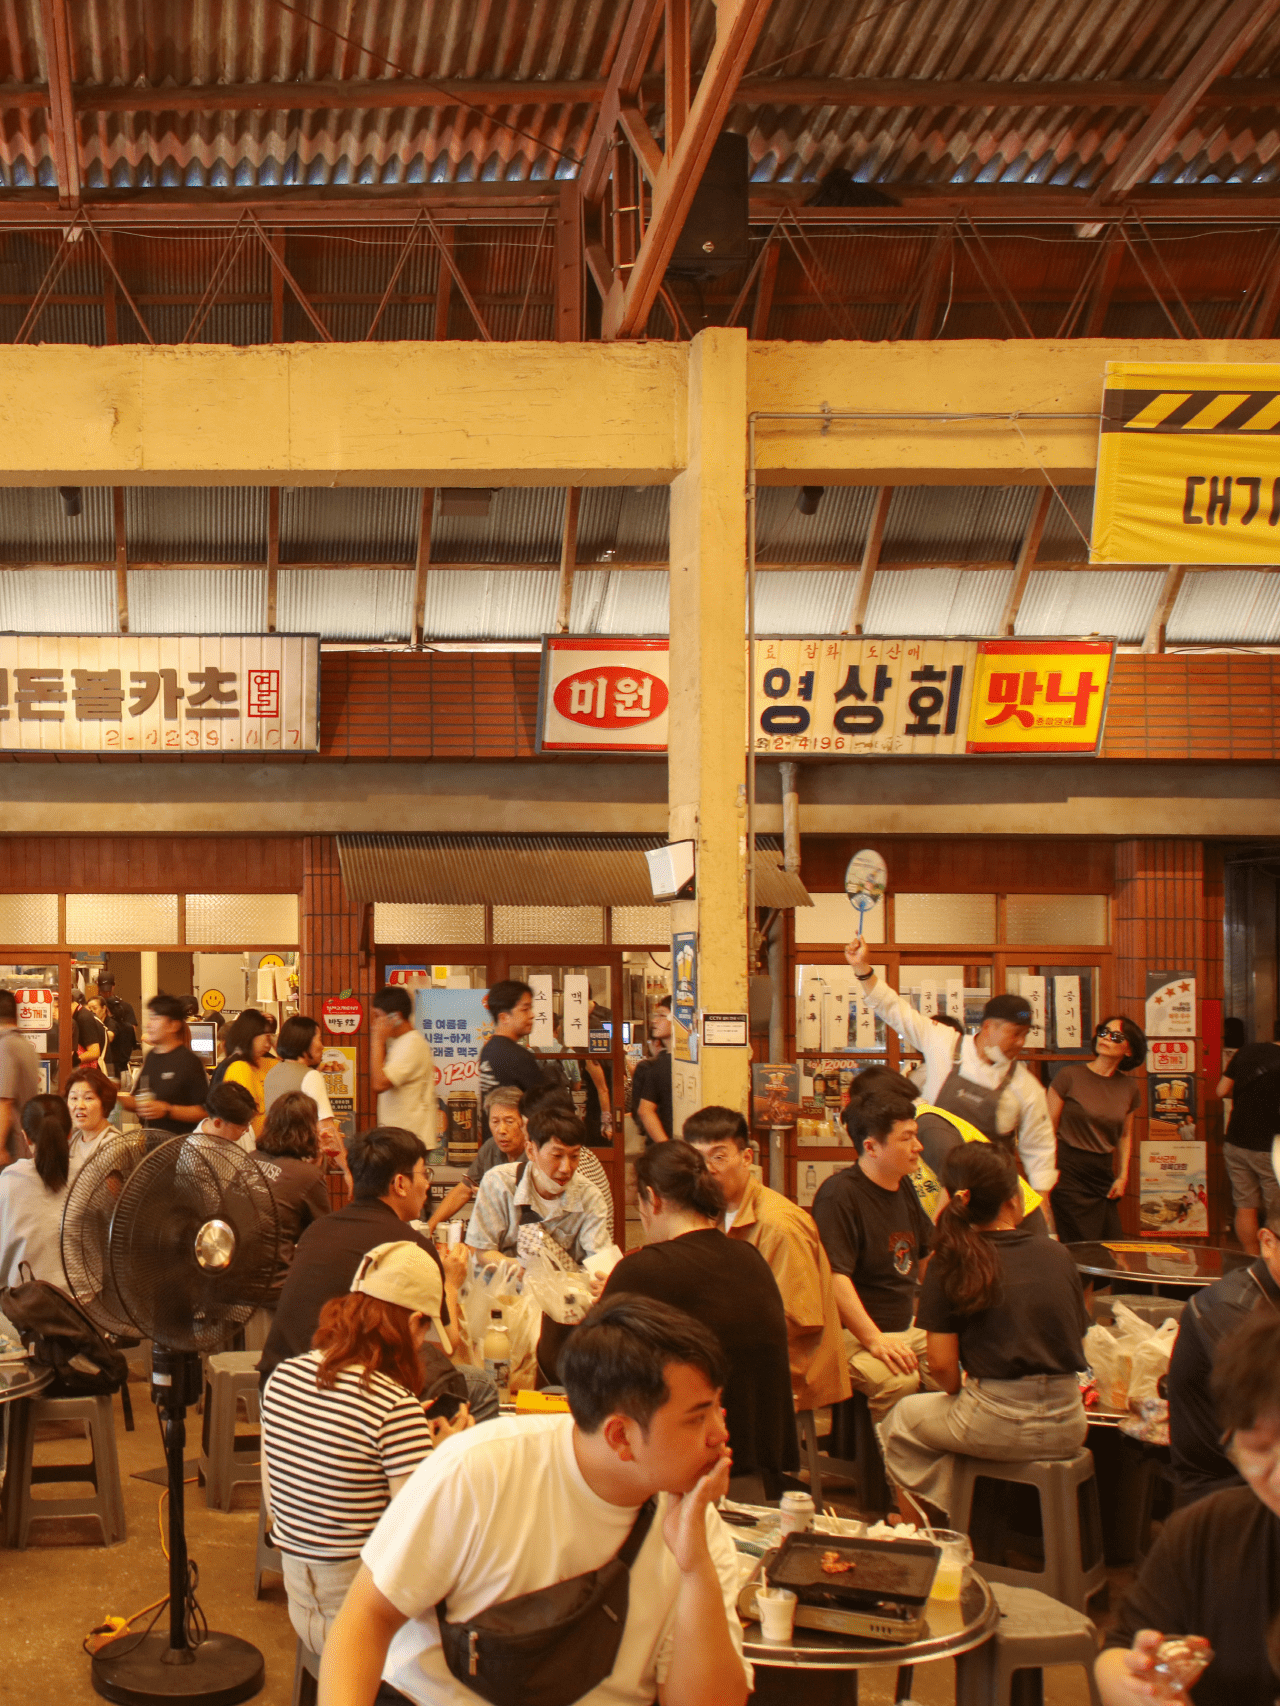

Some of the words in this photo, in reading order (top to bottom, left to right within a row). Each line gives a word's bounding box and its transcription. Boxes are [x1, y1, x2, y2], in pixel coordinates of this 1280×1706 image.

[805, 643, 839, 660] 잡화
[867, 644, 921, 660] 도산매
[569, 676, 653, 720] 미원
[761, 665, 964, 735] 영상회
[985, 671, 1099, 728] 맛나
[435, 1019, 467, 1029] 여름을
[535, 990, 547, 1024] 소주
[571, 991, 582, 1029] 맥주
[430, 1047, 454, 1057] 래줄
[457, 1047, 478, 1057] 맥주
[326, 1084, 348, 1095] 카츠
